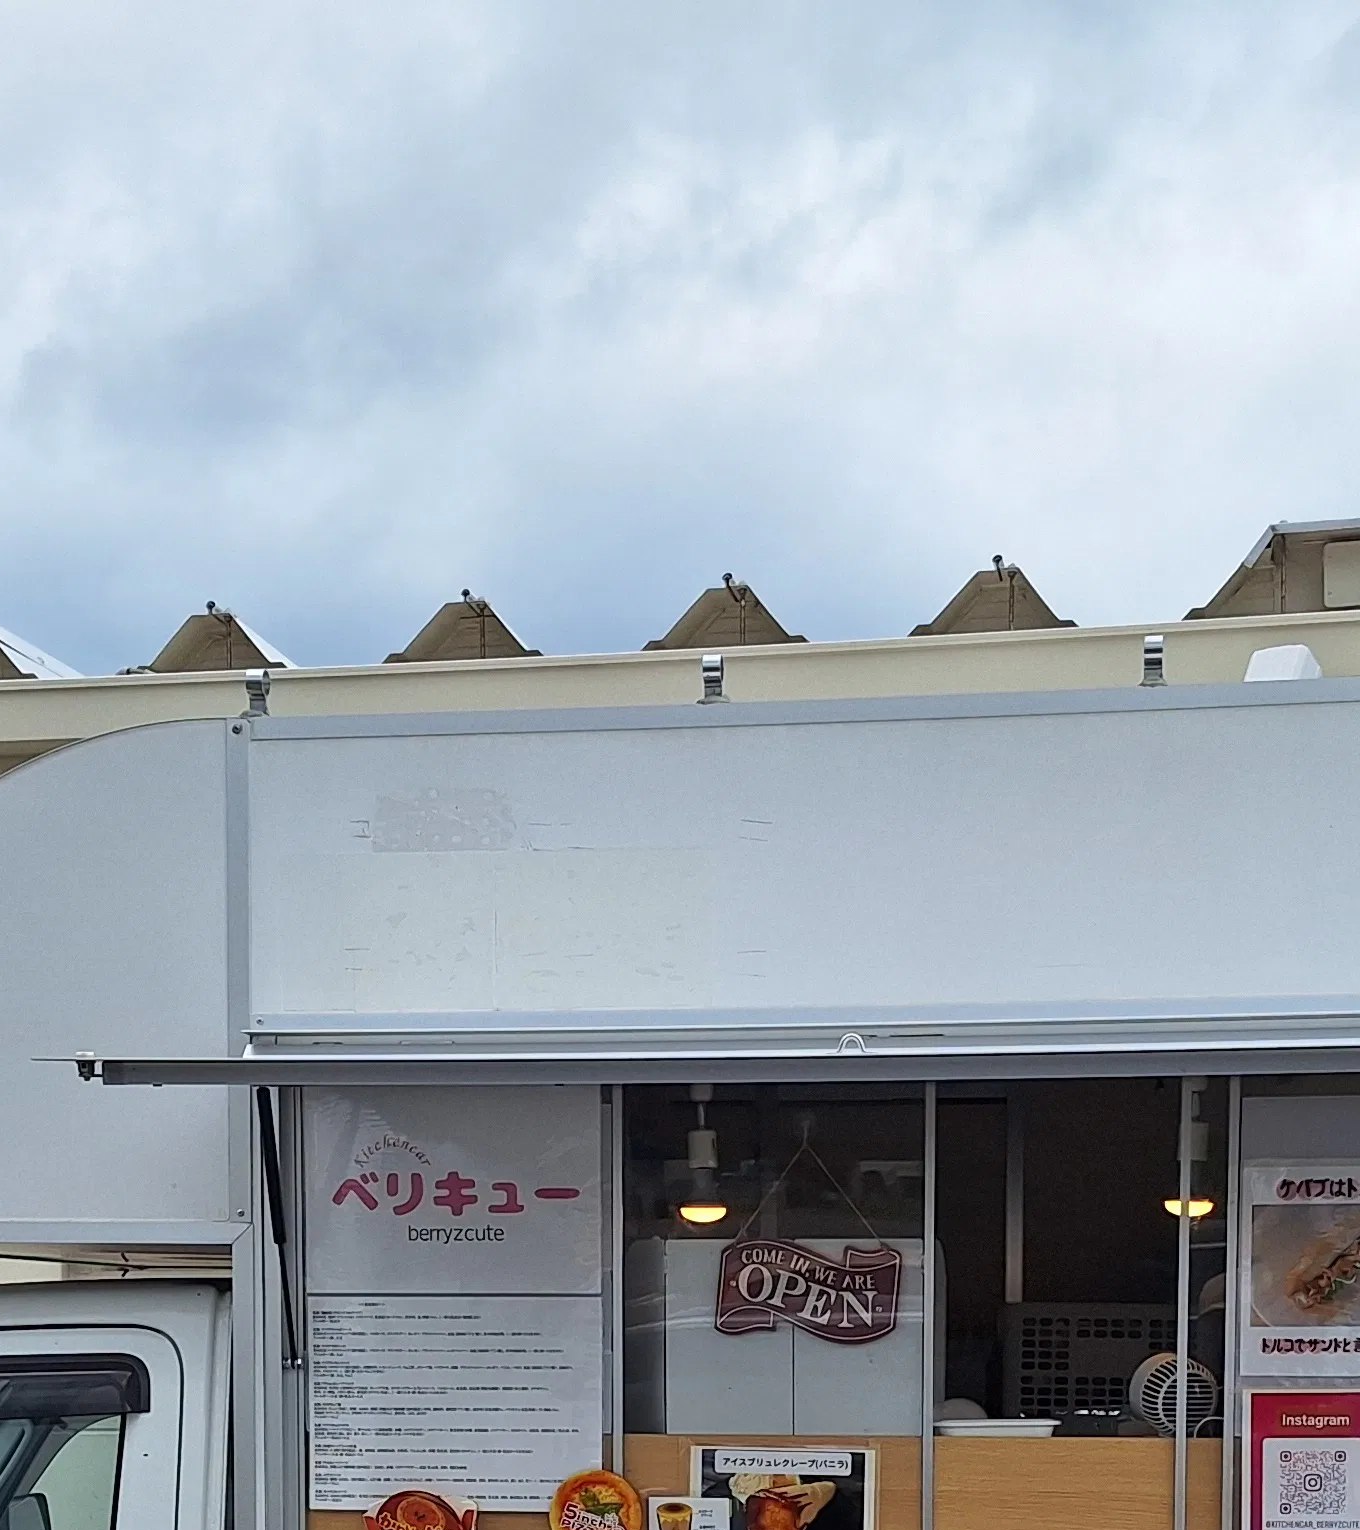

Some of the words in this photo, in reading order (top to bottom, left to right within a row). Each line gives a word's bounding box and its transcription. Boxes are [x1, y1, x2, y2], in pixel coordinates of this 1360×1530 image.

[332, 1171, 581, 1217] ベリキュー
[408, 1225, 505, 1244] berryzcute
[741, 1249, 786, 1265] COME
[814, 1265, 837, 1286] WE
[842, 1274, 876, 1289] ARE
[738, 1263, 879, 1328] OPEN
[1281, 1413, 1351, 1429] Instagram
